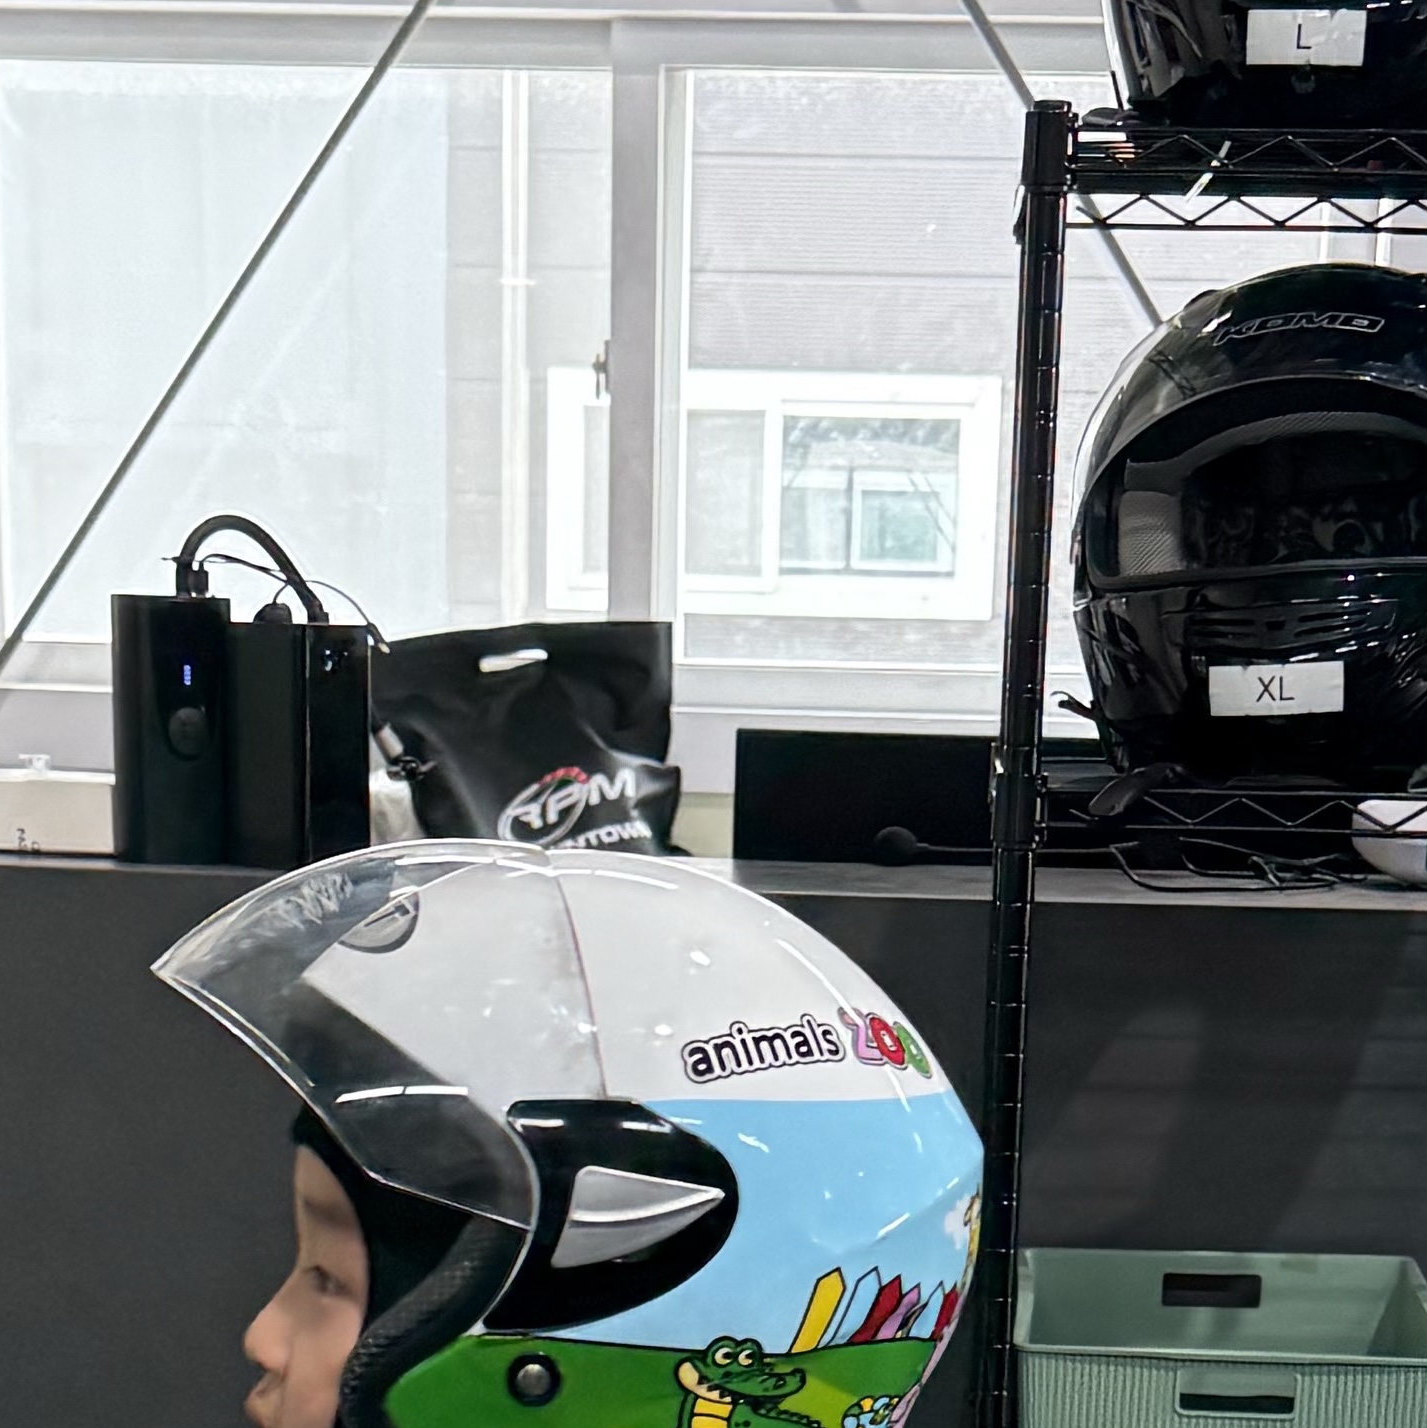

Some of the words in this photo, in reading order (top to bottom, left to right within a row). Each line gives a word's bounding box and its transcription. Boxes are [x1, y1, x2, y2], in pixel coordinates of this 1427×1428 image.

[1296, 23, 1313, 49] L
[1213, 311, 1385, 346] KOMO
[1255, 675, 1295, 703] XL
[502, 767, 637, 832] RPM
[681, 1013, 846, 1083] animals
